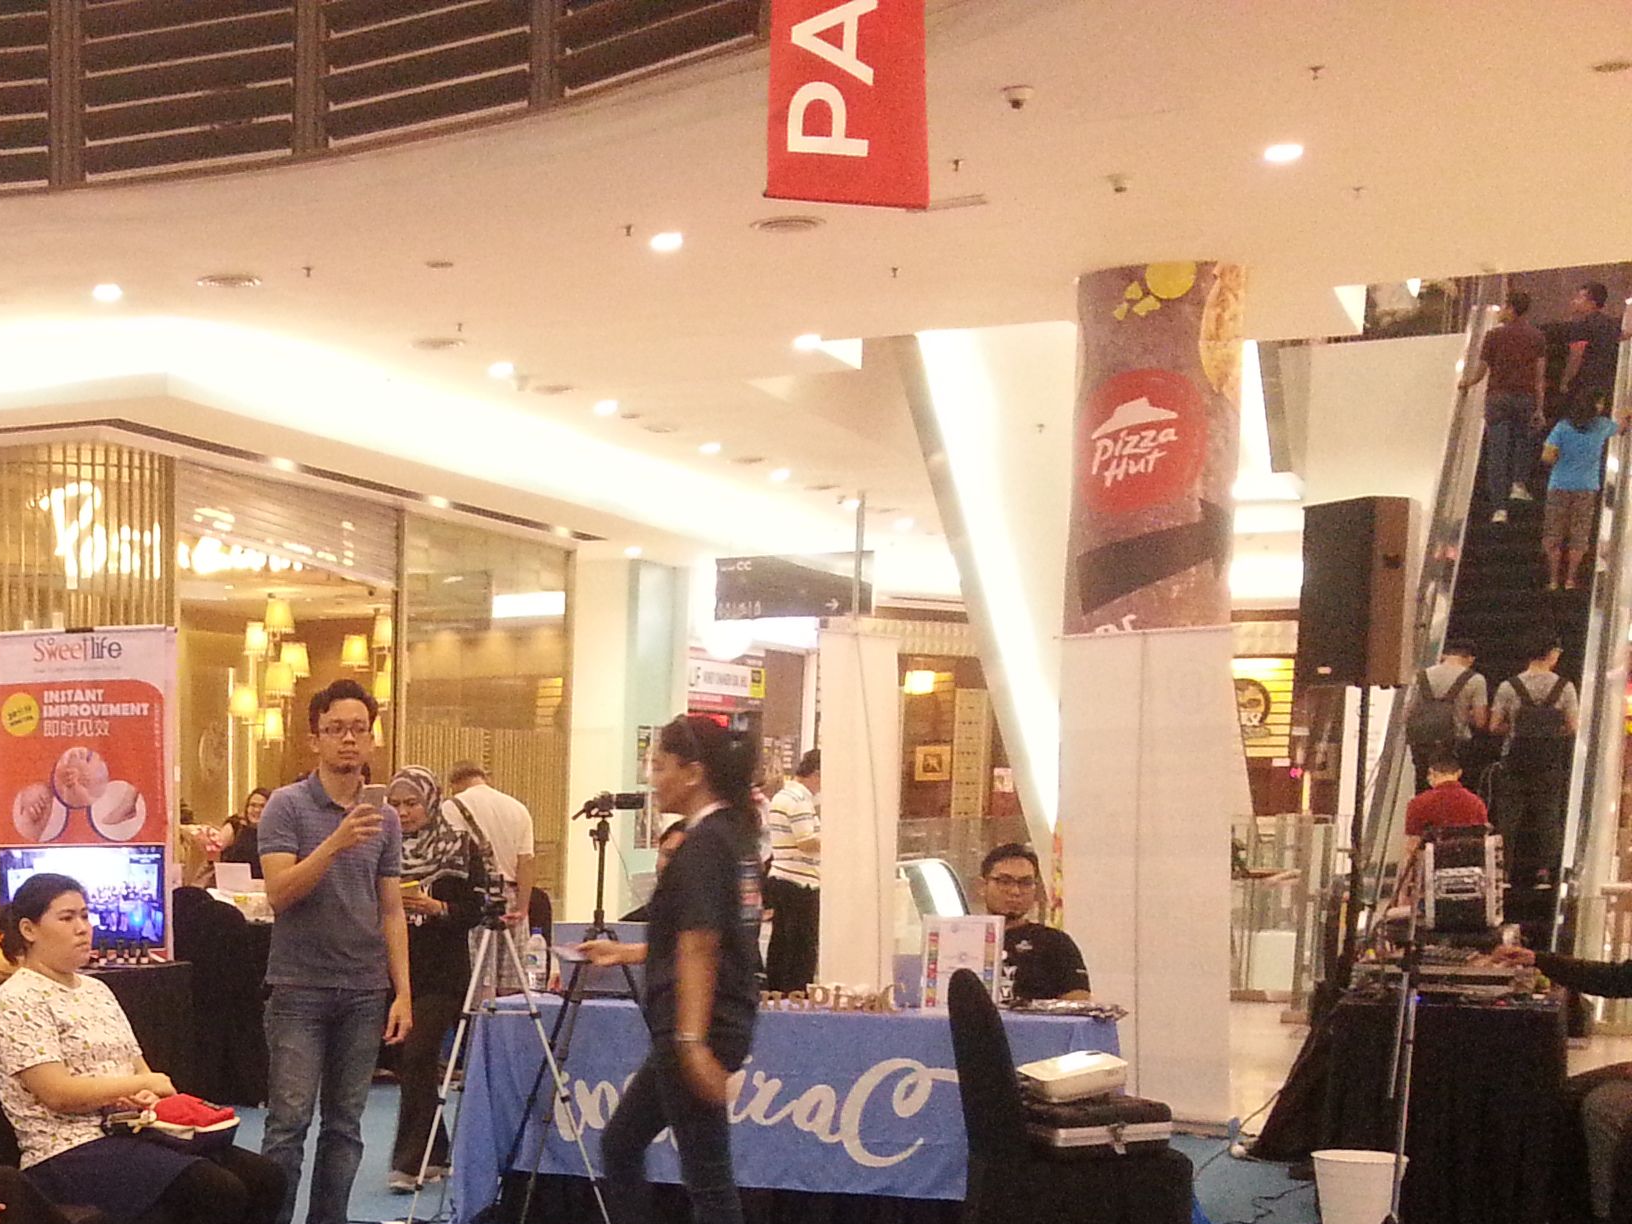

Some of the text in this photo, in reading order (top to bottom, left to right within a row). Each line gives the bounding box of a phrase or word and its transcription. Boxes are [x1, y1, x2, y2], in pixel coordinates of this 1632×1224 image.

[786, 0, 879, 158] PA
[1091, 427, 1179, 476] Pizza
[1104, 450, 1168, 488] Hut
[42, 703, 150, 718] IMPROVEMENT
[43, 689, 104, 704] INSTANT
[43, 719, 110, 737] 即时见效
